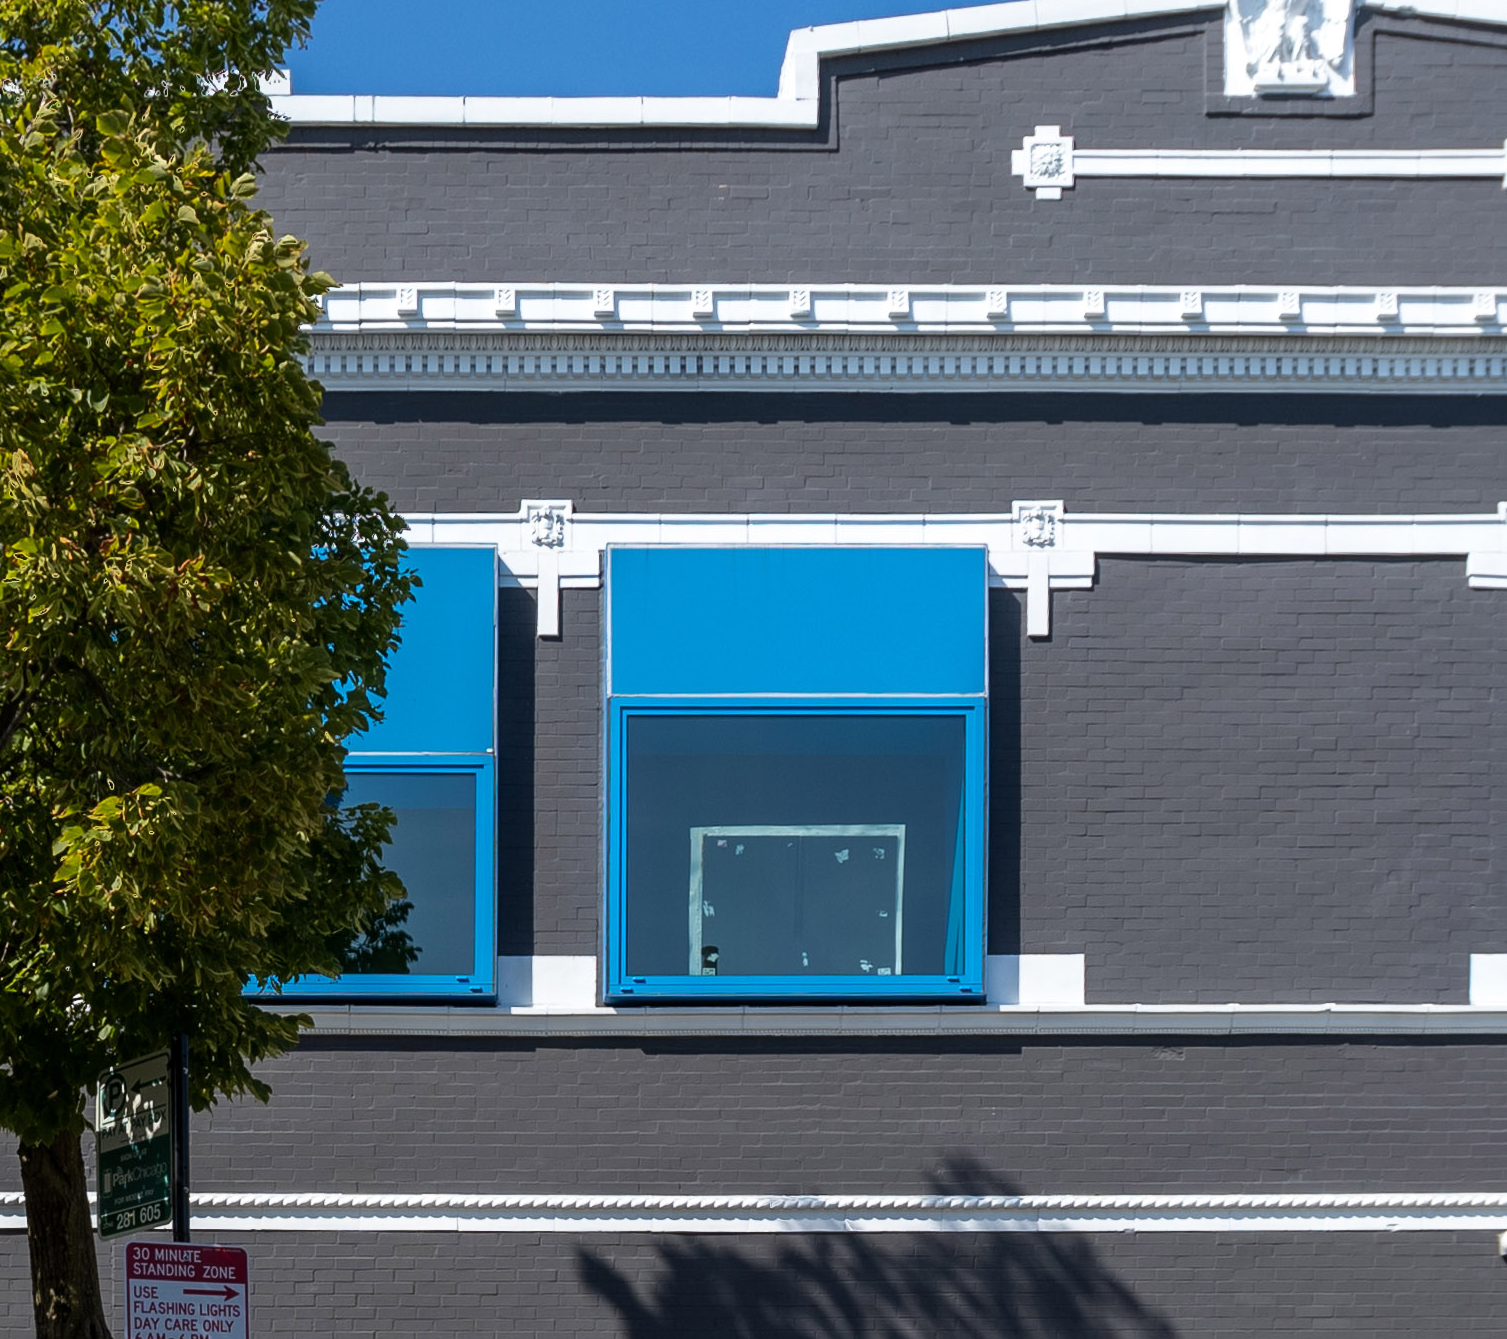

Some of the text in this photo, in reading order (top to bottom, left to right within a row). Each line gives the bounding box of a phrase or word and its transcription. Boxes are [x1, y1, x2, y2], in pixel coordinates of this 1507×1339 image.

[116, 1210, 136, 1230] 281
[140, 1203, 161, 1224] 605
[133, 1247, 150, 1260] 30
[155, 1248, 202, 1263] MINUTE
[133, 1262, 236, 1279] STANDING ZONE
[133, 1285, 159, 1299] USE
[133, 1301, 241, 1318] FLASHING LIGHTS
[134, 1316, 234, 1333] DAY CARE ONLY
